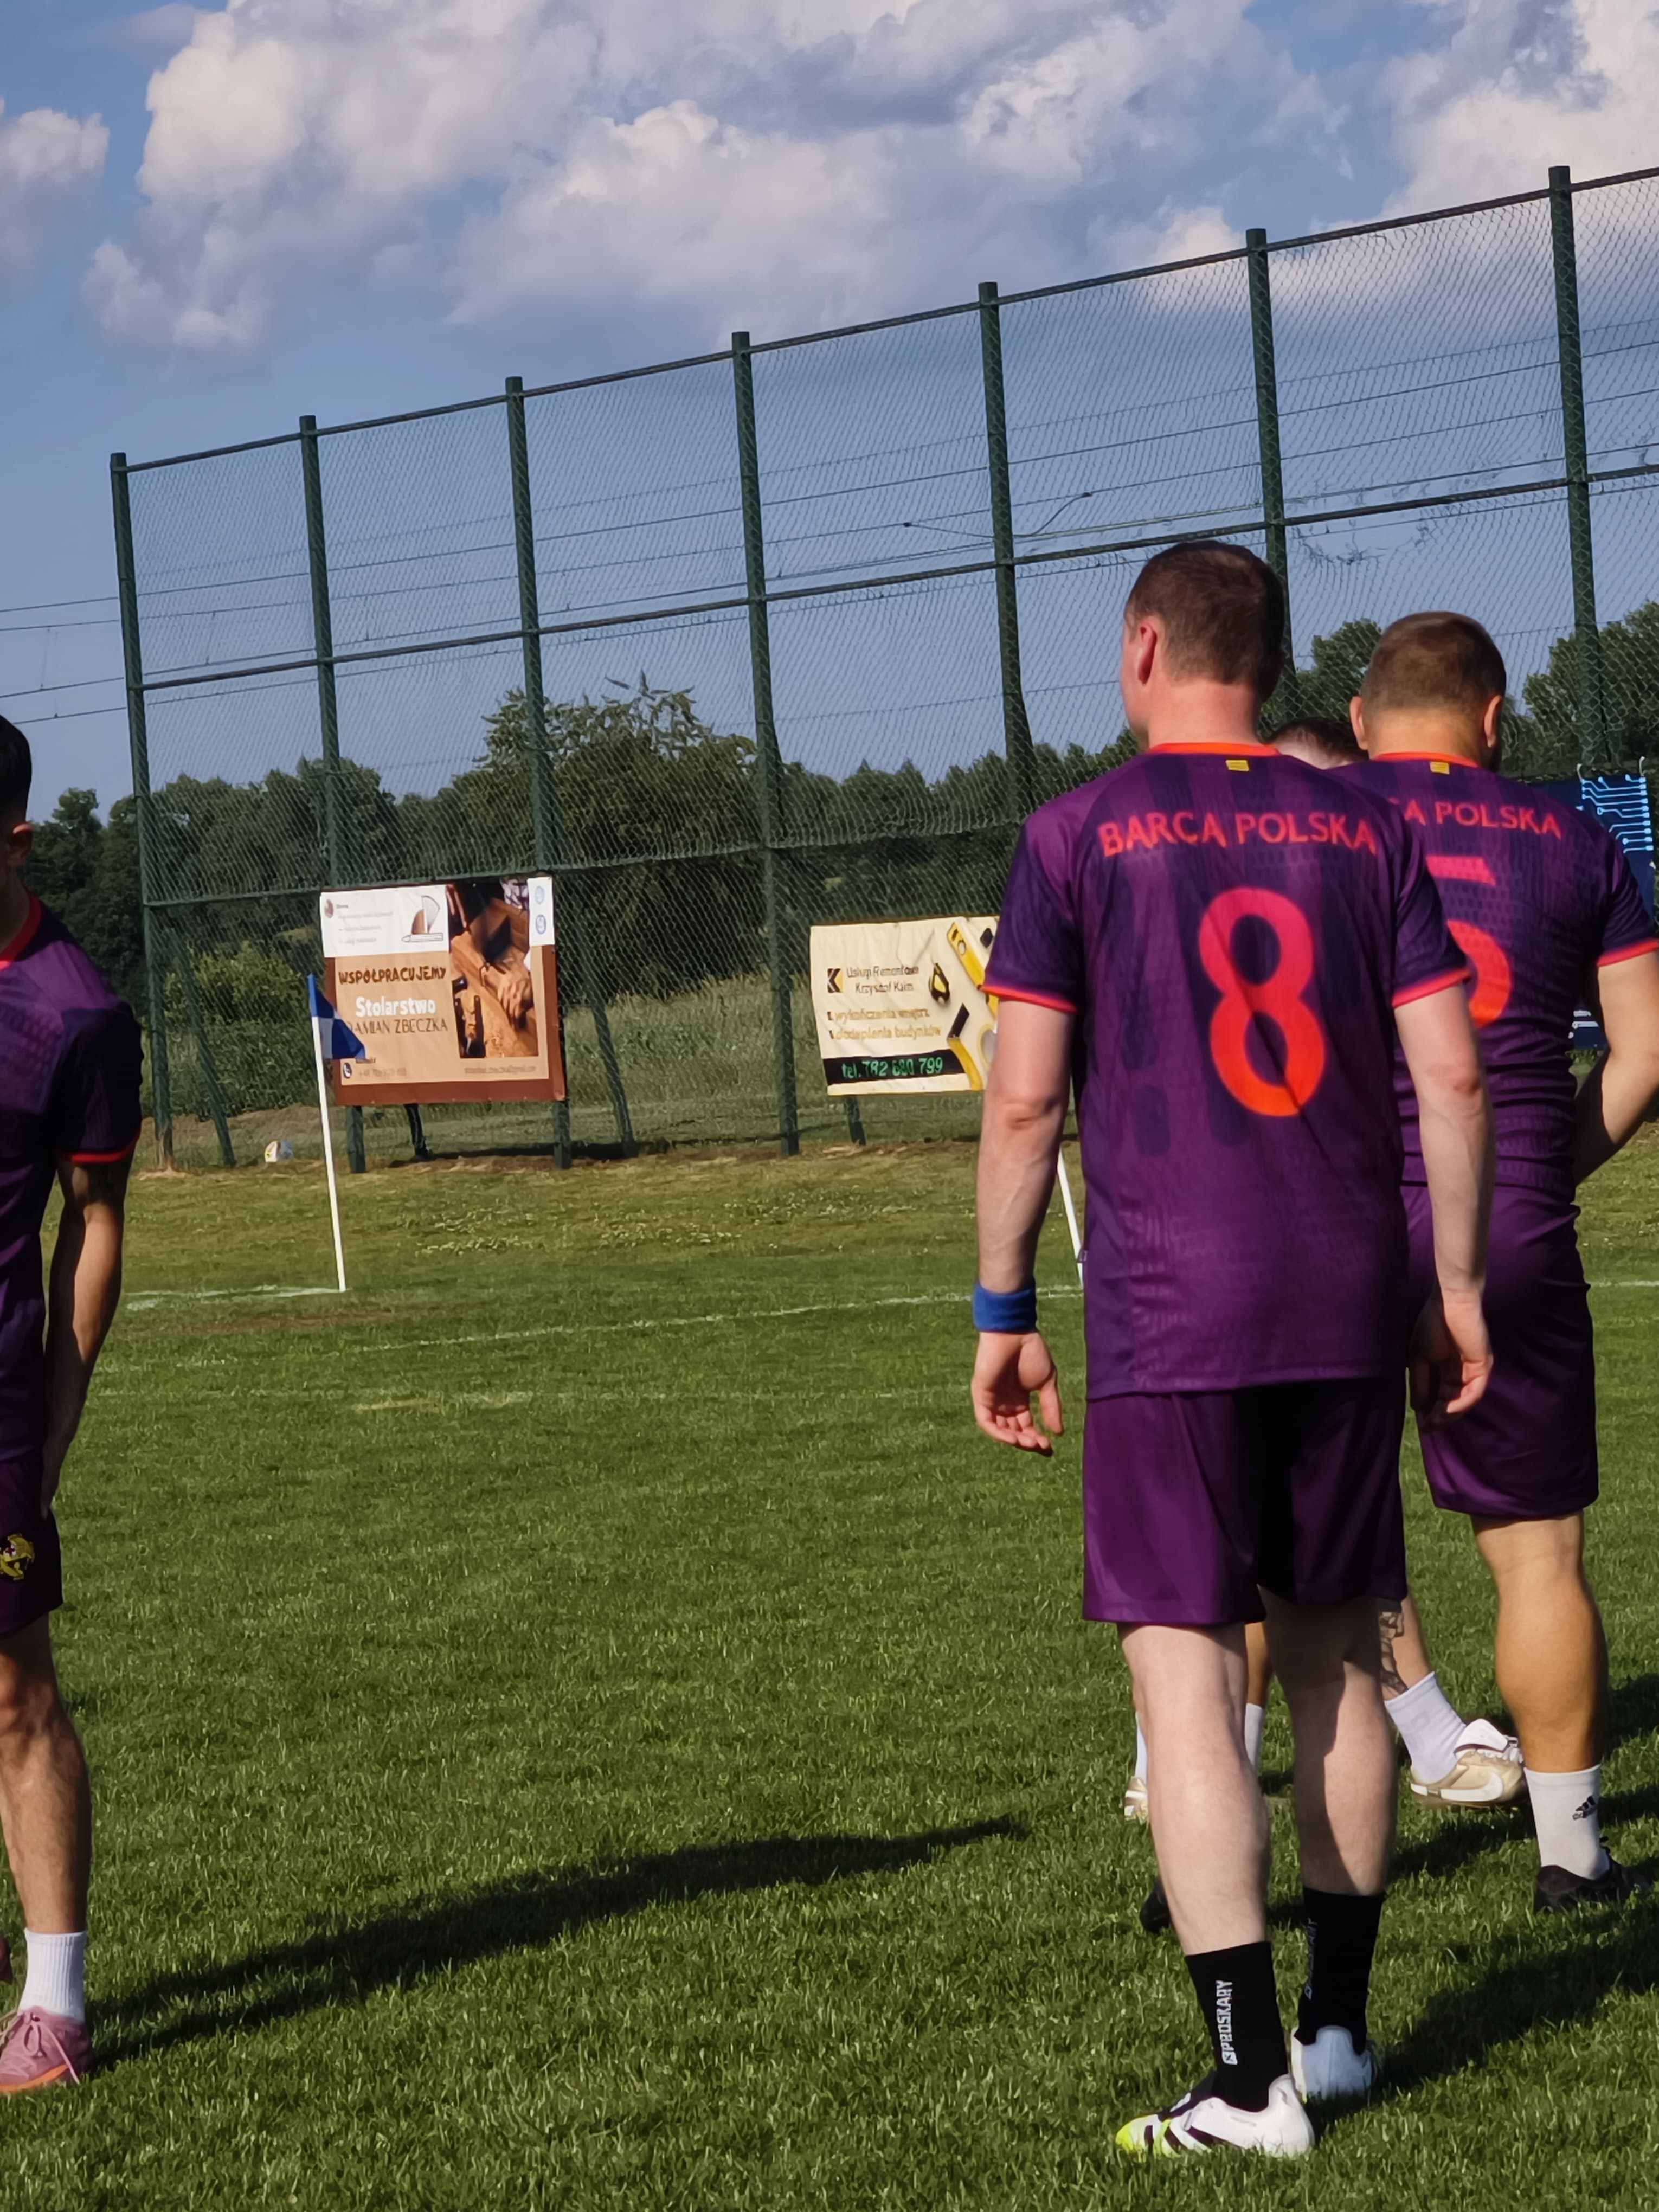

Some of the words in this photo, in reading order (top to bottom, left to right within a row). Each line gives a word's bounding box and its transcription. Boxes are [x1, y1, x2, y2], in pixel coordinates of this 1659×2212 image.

[1098, 810, 1227, 857] BARCA
[1235, 811, 1378, 857] POLSKA
[1435, 800, 1562, 840] POLSKA
[355, 995, 436, 1018] Stolarstwo
[1198, 886, 1326, 1117] 8
[918, 1057, 943, 1075] 799
